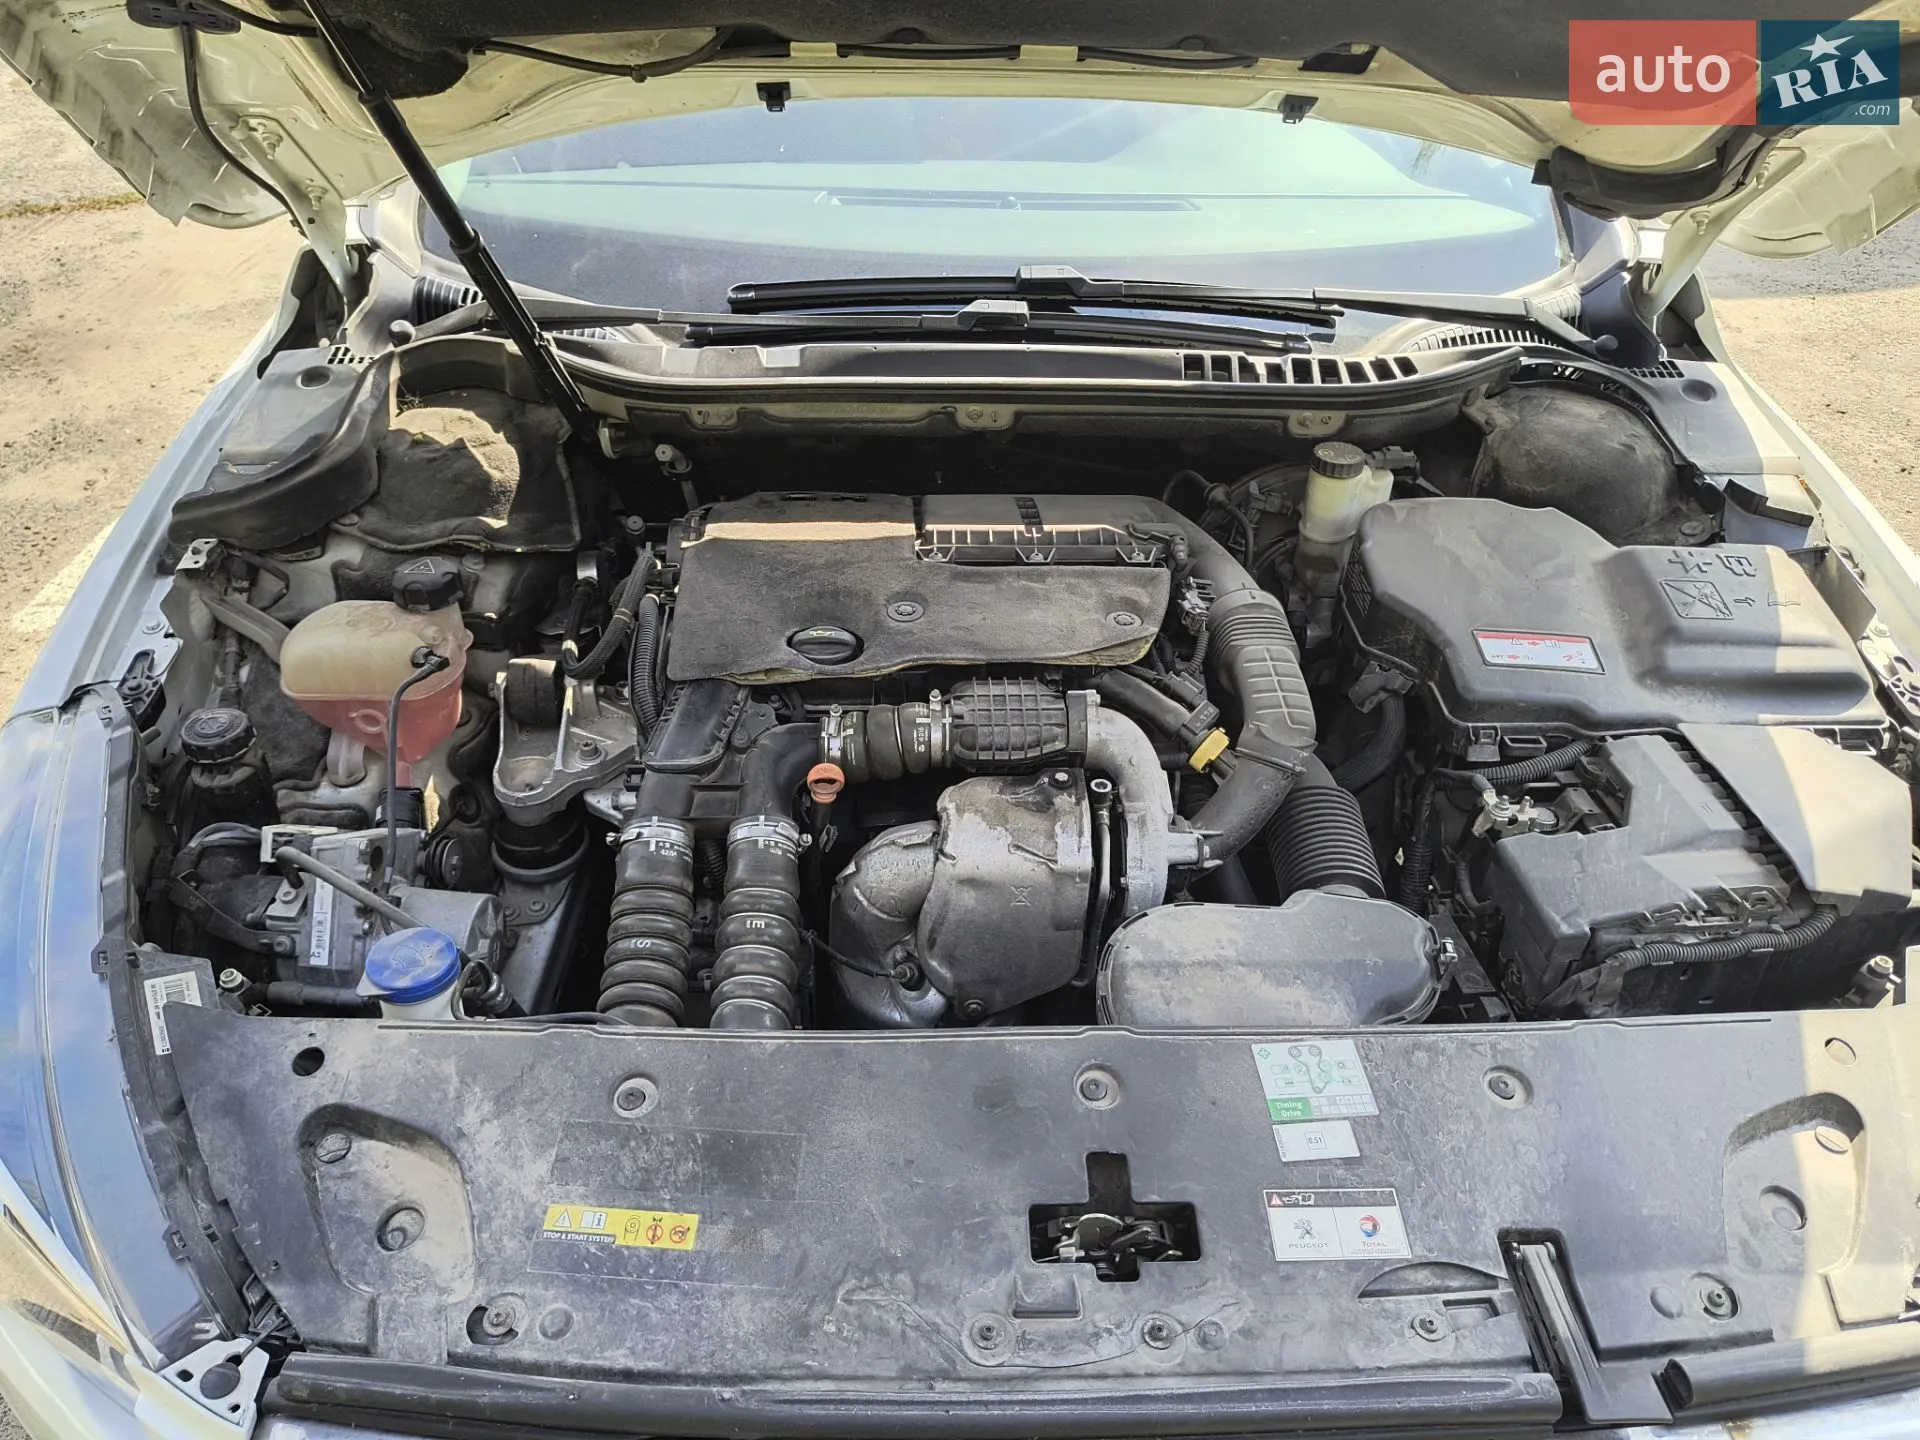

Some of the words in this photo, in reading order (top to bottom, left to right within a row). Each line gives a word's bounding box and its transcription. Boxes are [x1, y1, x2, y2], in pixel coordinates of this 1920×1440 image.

[1276, 1101, 1303, 1109] Timing
[567, 1233, 588, 1241] START
[589, 1234, 615, 1243] SYSTEM
